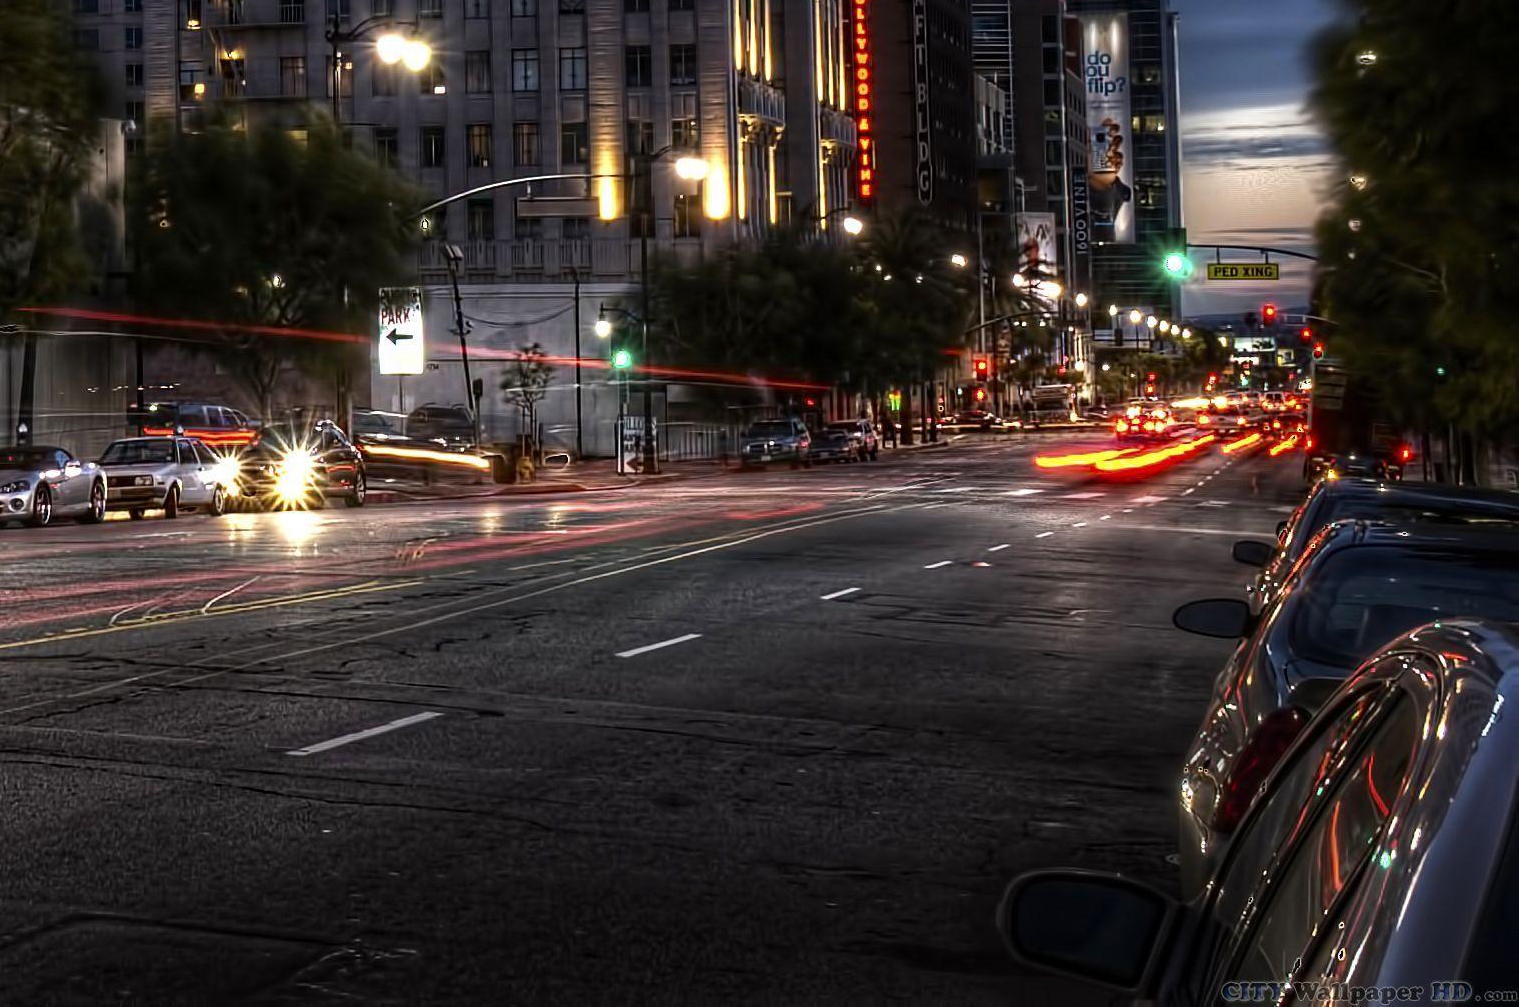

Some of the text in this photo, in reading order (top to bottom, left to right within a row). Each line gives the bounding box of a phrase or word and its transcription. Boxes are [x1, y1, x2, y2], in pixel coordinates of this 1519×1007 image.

[1087, 50, 1112, 65] do
[1086, 65, 1110, 77] ou
[1087, 76, 1127, 96] flip?
[917, 84, 930, 191] BLDG
[860, 138, 871, 196] VINE
[1076, 219, 1087, 254] 1600
[1213, 266, 1273, 277] PED XING
